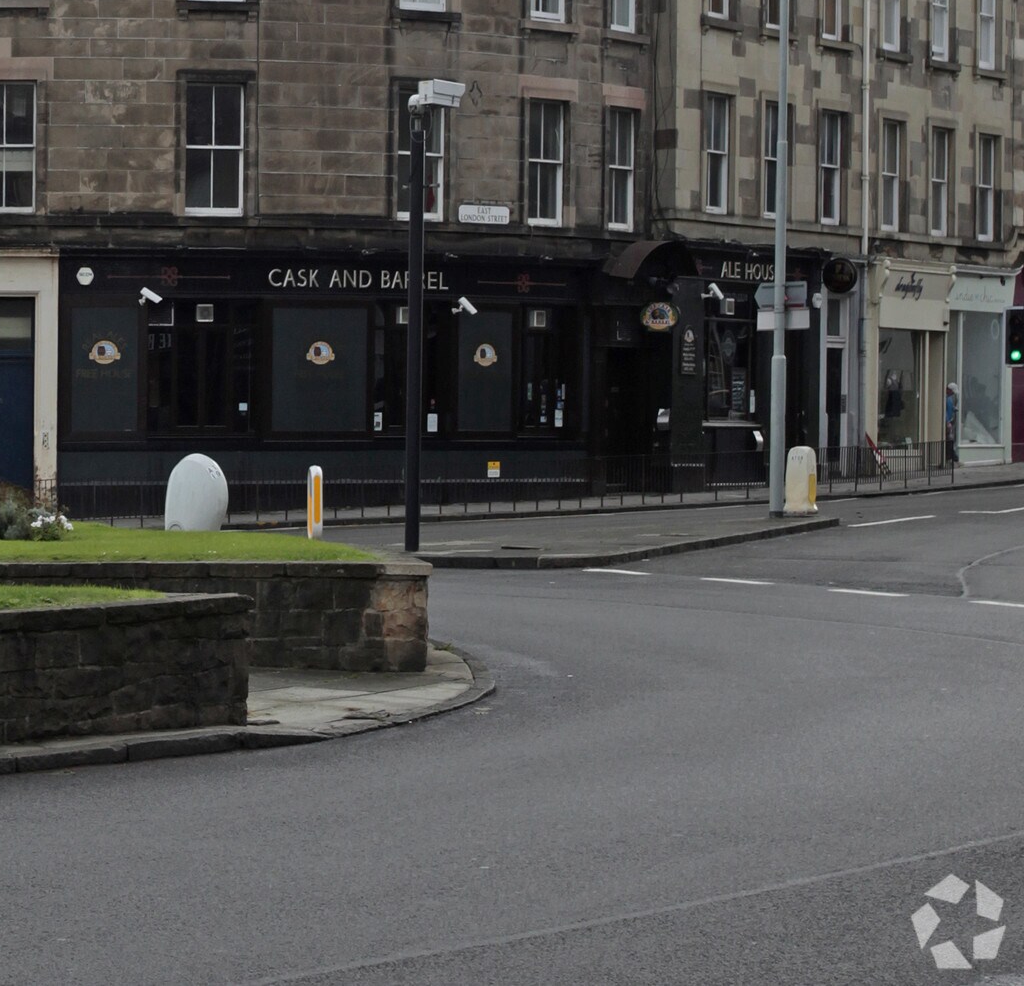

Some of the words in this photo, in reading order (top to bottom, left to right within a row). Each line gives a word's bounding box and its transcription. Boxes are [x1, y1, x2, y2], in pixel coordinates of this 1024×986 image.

[460, 214, 486, 222] LONDON
[487, 215, 508, 223] STREET
[268, 268, 319, 288] CASK
[329, 269, 372, 289] AND
[721, 261, 741, 278] ALE
[744, 263, 774, 281] HOUS
